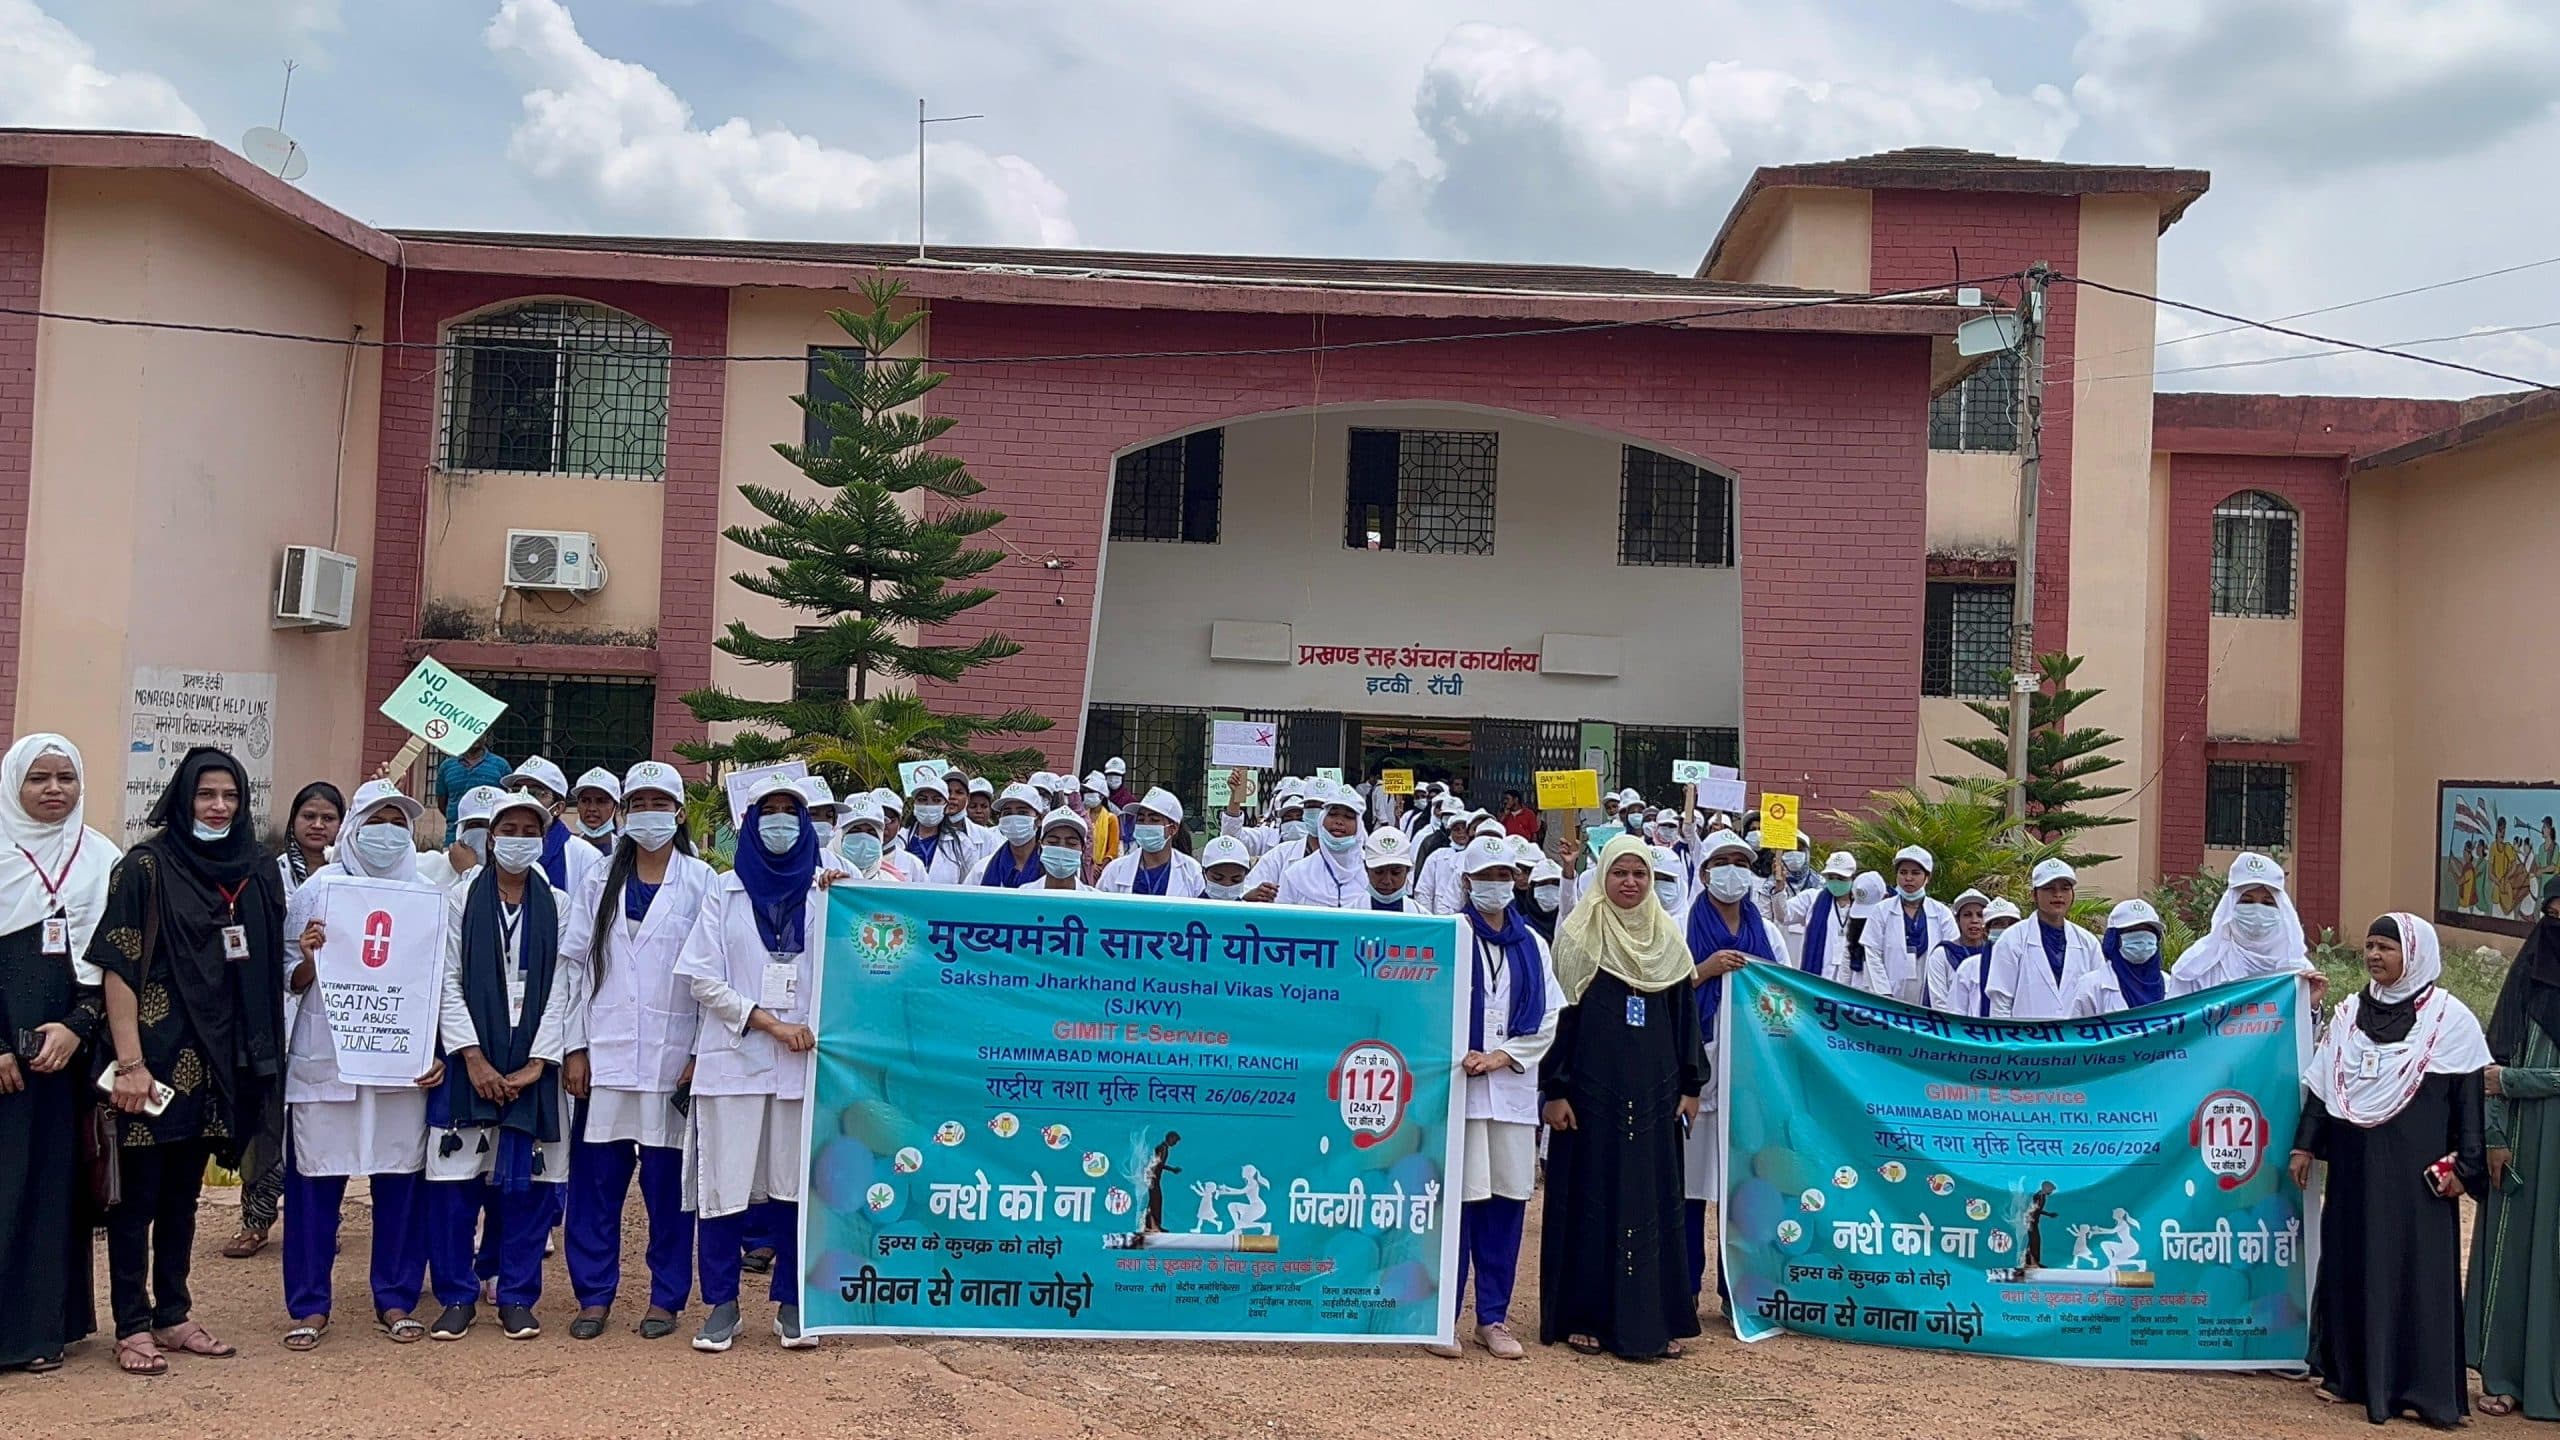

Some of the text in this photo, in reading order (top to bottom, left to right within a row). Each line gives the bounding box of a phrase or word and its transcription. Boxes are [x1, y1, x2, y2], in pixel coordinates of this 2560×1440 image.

[1298, 642, 1539, 673] प्रखण्ड सह अंचल कार्यालय
[418, 668, 448, 692] NO
[135, 689, 269, 716] MGNREGA GRIEVANCE HELP LINE
[418, 690, 488, 735] SMOKING
[928, 914, 1339, 969] मुख्यमंत्री सारथी योजना
[940, 968, 1340, 1003] Saksham Jharkhand Kaushal Vikas Yojana
[1377, 964, 1438, 982] GIMIT
[324, 992, 404, 1011] AGAINST
[387, 985, 402, 994] DAY
[362, 1012, 398, 1024] ABUSE
[1104, 998, 1182, 1020] (SJKVY)
[1814, 996, 1952, 1039] मुख्यमंत्री
[2076, 1011, 2187, 1042] योजना
[1053, 1020, 1231, 1046] GIMIT E-Service
[2223, 1020, 2284, 1035] GIMIT
[341, 1034, 409, 1053] JUNE 26
[1827, 1035, 2187, 1066] Saksham Jharkhand Kaushal Vikas Yojana
[977, 1046, 1298, 1072] SHAMIMABAD MOHALLAH, ITKI, RANCHI
[986, 1072, 1297, 1106] राष्ट्रीय नशा मुक्ति दिवस 26/06/2024
[1345, 1068, 1396, 1101] 112
[1969, 1069, 2041, 1083] (SJKVY)
[1925, 1083, 2087, 1104] GIMIT E-Service
[1349, 1102, 1382, 1115] (24x7)
[1866, 1103, 2159, 1126] SHAMIMABAD MOHALLAH, ITKI, RANCHI
[1874, 1126, 2161, 1158] राष्ट्रीय नशा मुक्ति दिवस 26/06/2024
[2205, 1117, 2253, 1146] 112
[2210, 1148, 2242, 1159] (24x7)
[929, 1168, 1096, 1222] नशे को ना
[1370, 1179, 1405, 1229] को
[1409, 1179, 1440, 1234] हाँ
[878, 1232, 1063, 1260] ड्रग्स के कुचक्र को तोड़ो
[1832, 1208, 1979, 1259] नशे को ना
[2237, 1217, 2269, 1263] को
[2273, 1216, 2300, 1267] हाँ
[1789, 1264, 1951, 1290] ड्रग्स के कुचक्र को तोड़ो
[839, 1264, 1094, 1318] जीवन से नाता जोड़ो
[1757, 1289, 1984, 1344] जीवन से नाता जोड़ो
